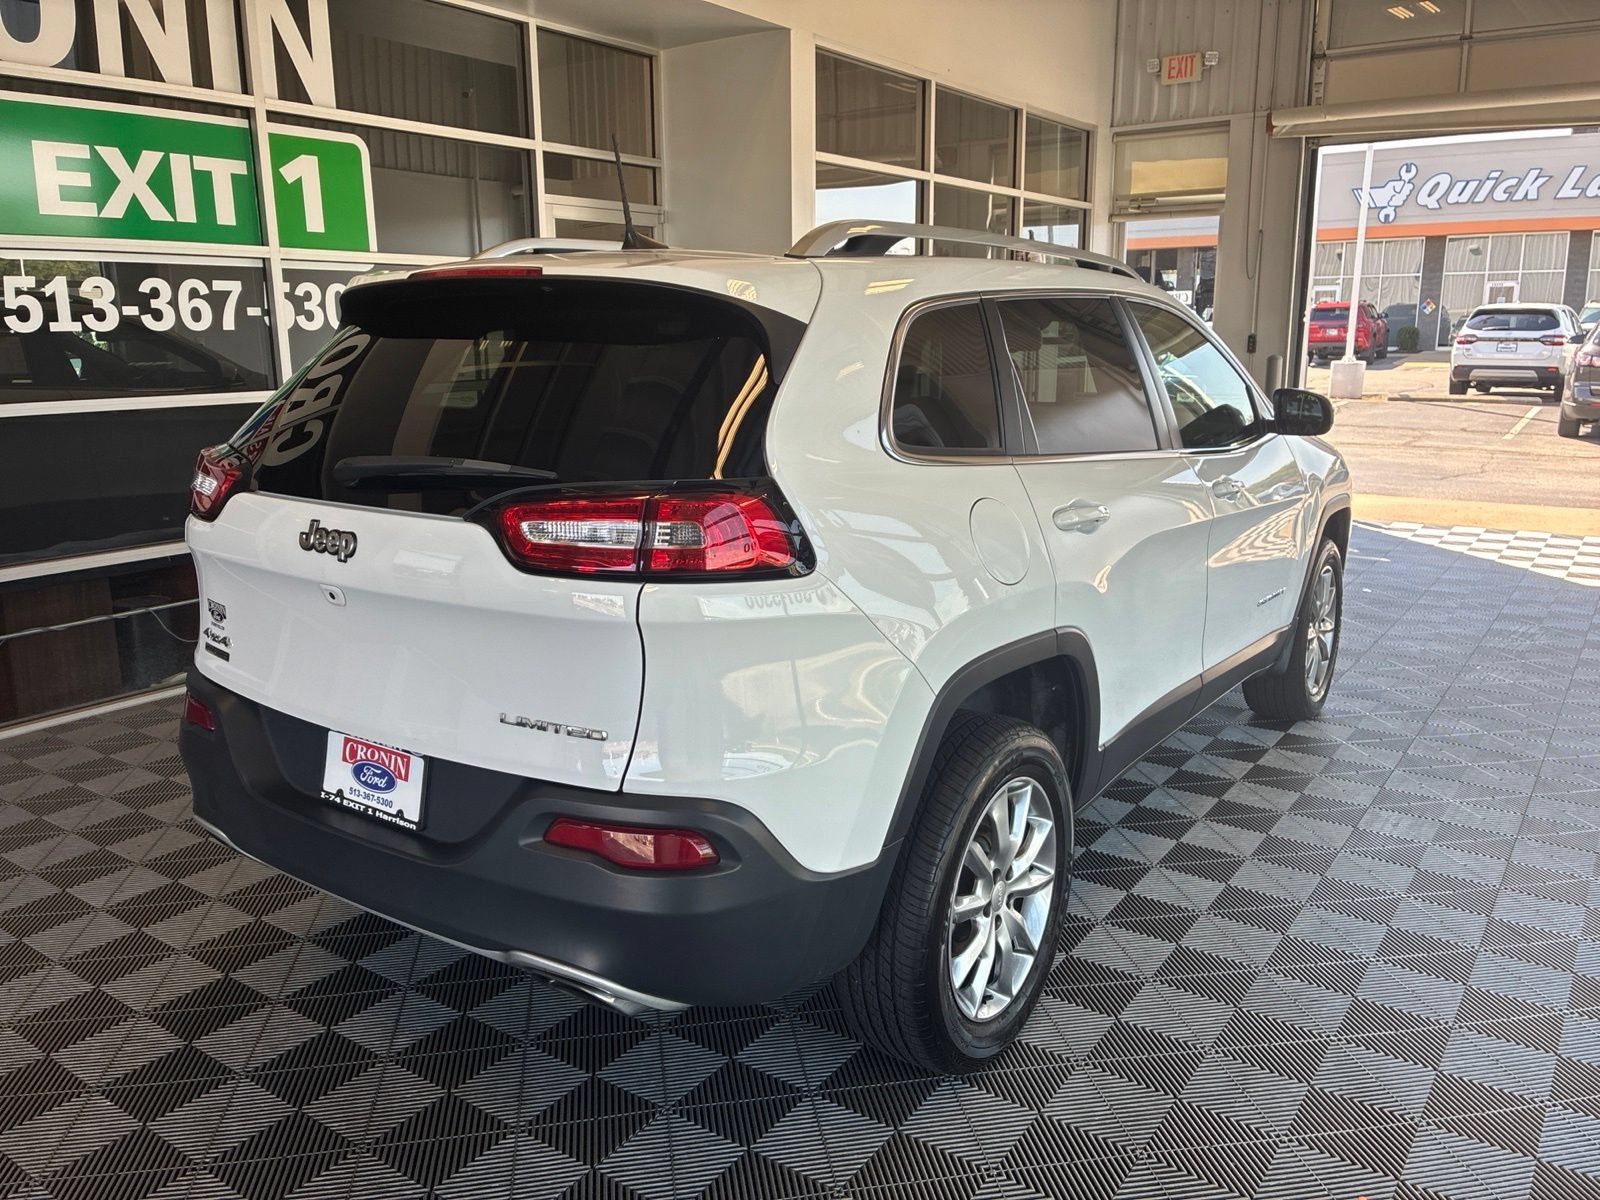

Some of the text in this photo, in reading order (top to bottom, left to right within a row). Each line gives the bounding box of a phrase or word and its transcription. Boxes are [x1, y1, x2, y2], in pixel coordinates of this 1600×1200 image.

[1167, 54, 1197, 80] EXIT
[32, 139, 326, 234] EXIT 1
[1416, 167, 1552, 210] Quick
[298, 519, 358, 563] Jeep
[499, 712, 608, 741] LIMITED
[345, 741, 408, 780] CRONIN
[360, 765, 388, 788] Ford
[348, 786, 394, 809] 513-367-5300
[342, 798, 366, 812] EXIT
[375, 810, 417, 831] Harrison
